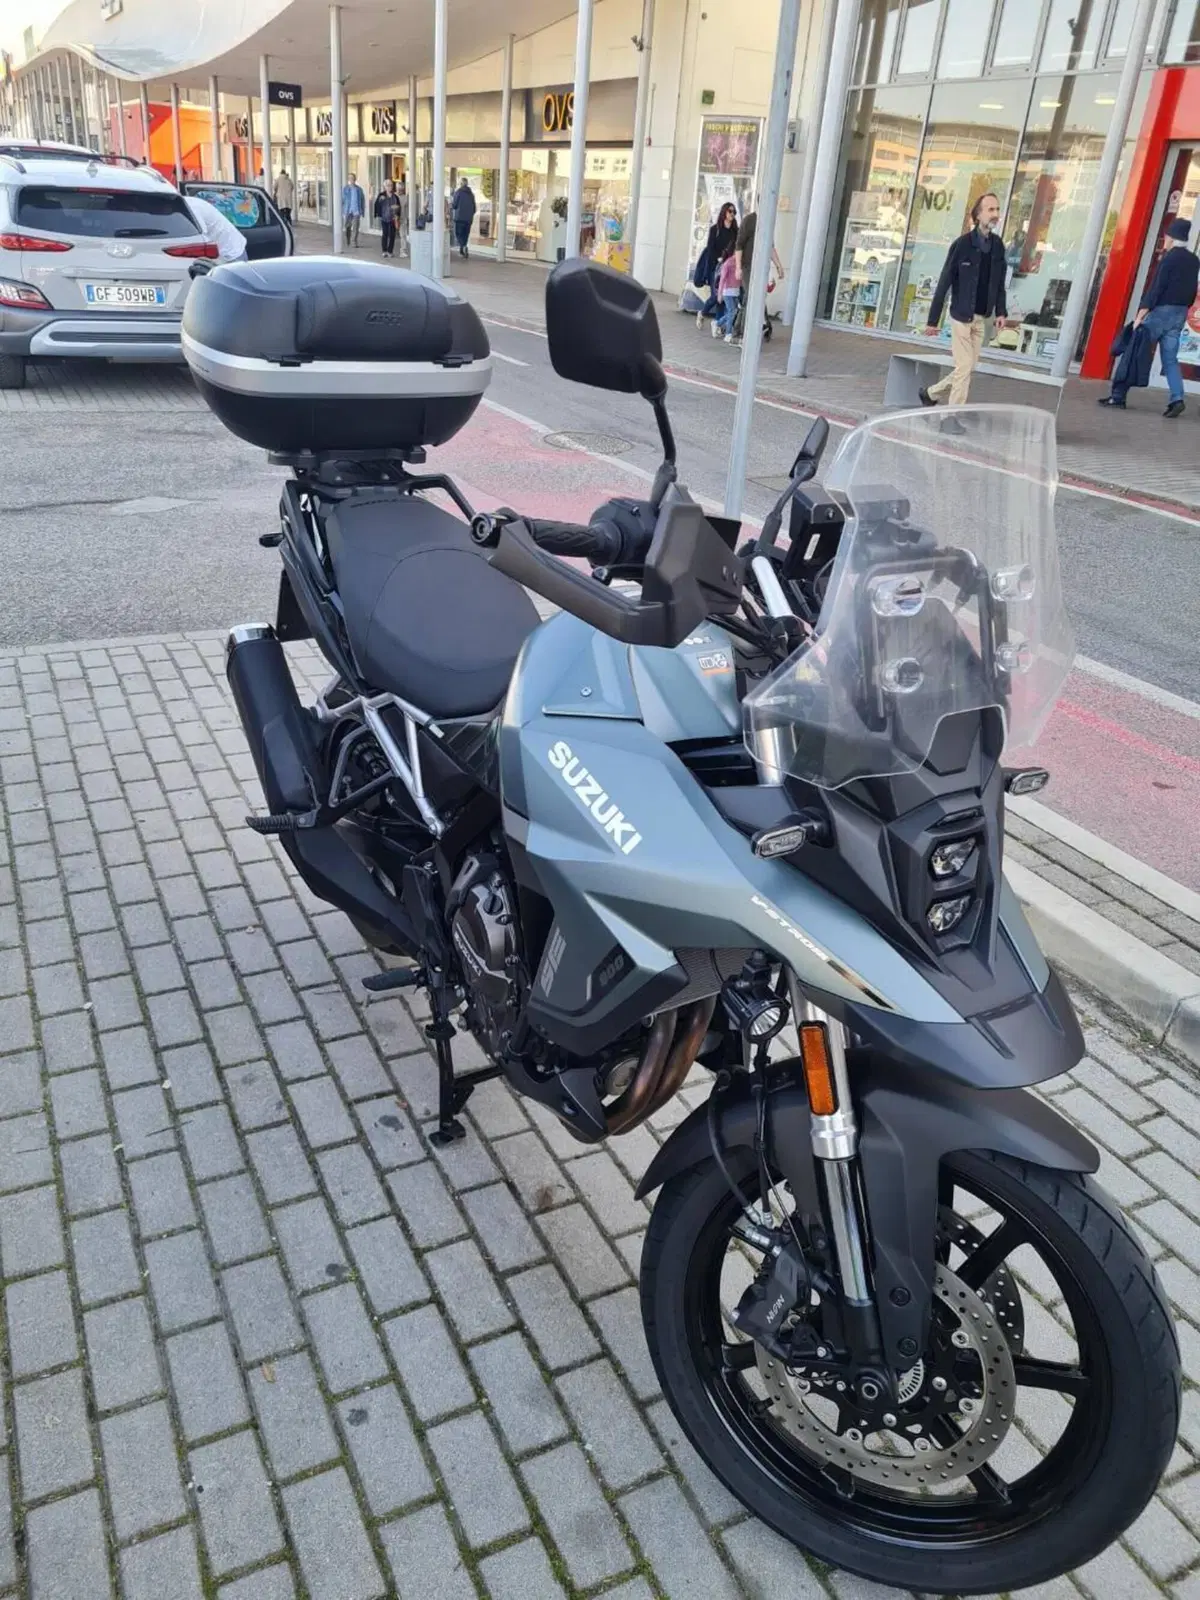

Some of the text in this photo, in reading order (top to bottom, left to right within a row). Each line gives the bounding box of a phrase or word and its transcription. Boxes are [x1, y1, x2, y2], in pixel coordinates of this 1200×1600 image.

[278, 90, 294, 100] OVS
[921, 189, 955, 211] NO!
[117, 288, 156, 302] 509WB
[547, 740, 643, 855] SUZUKI
